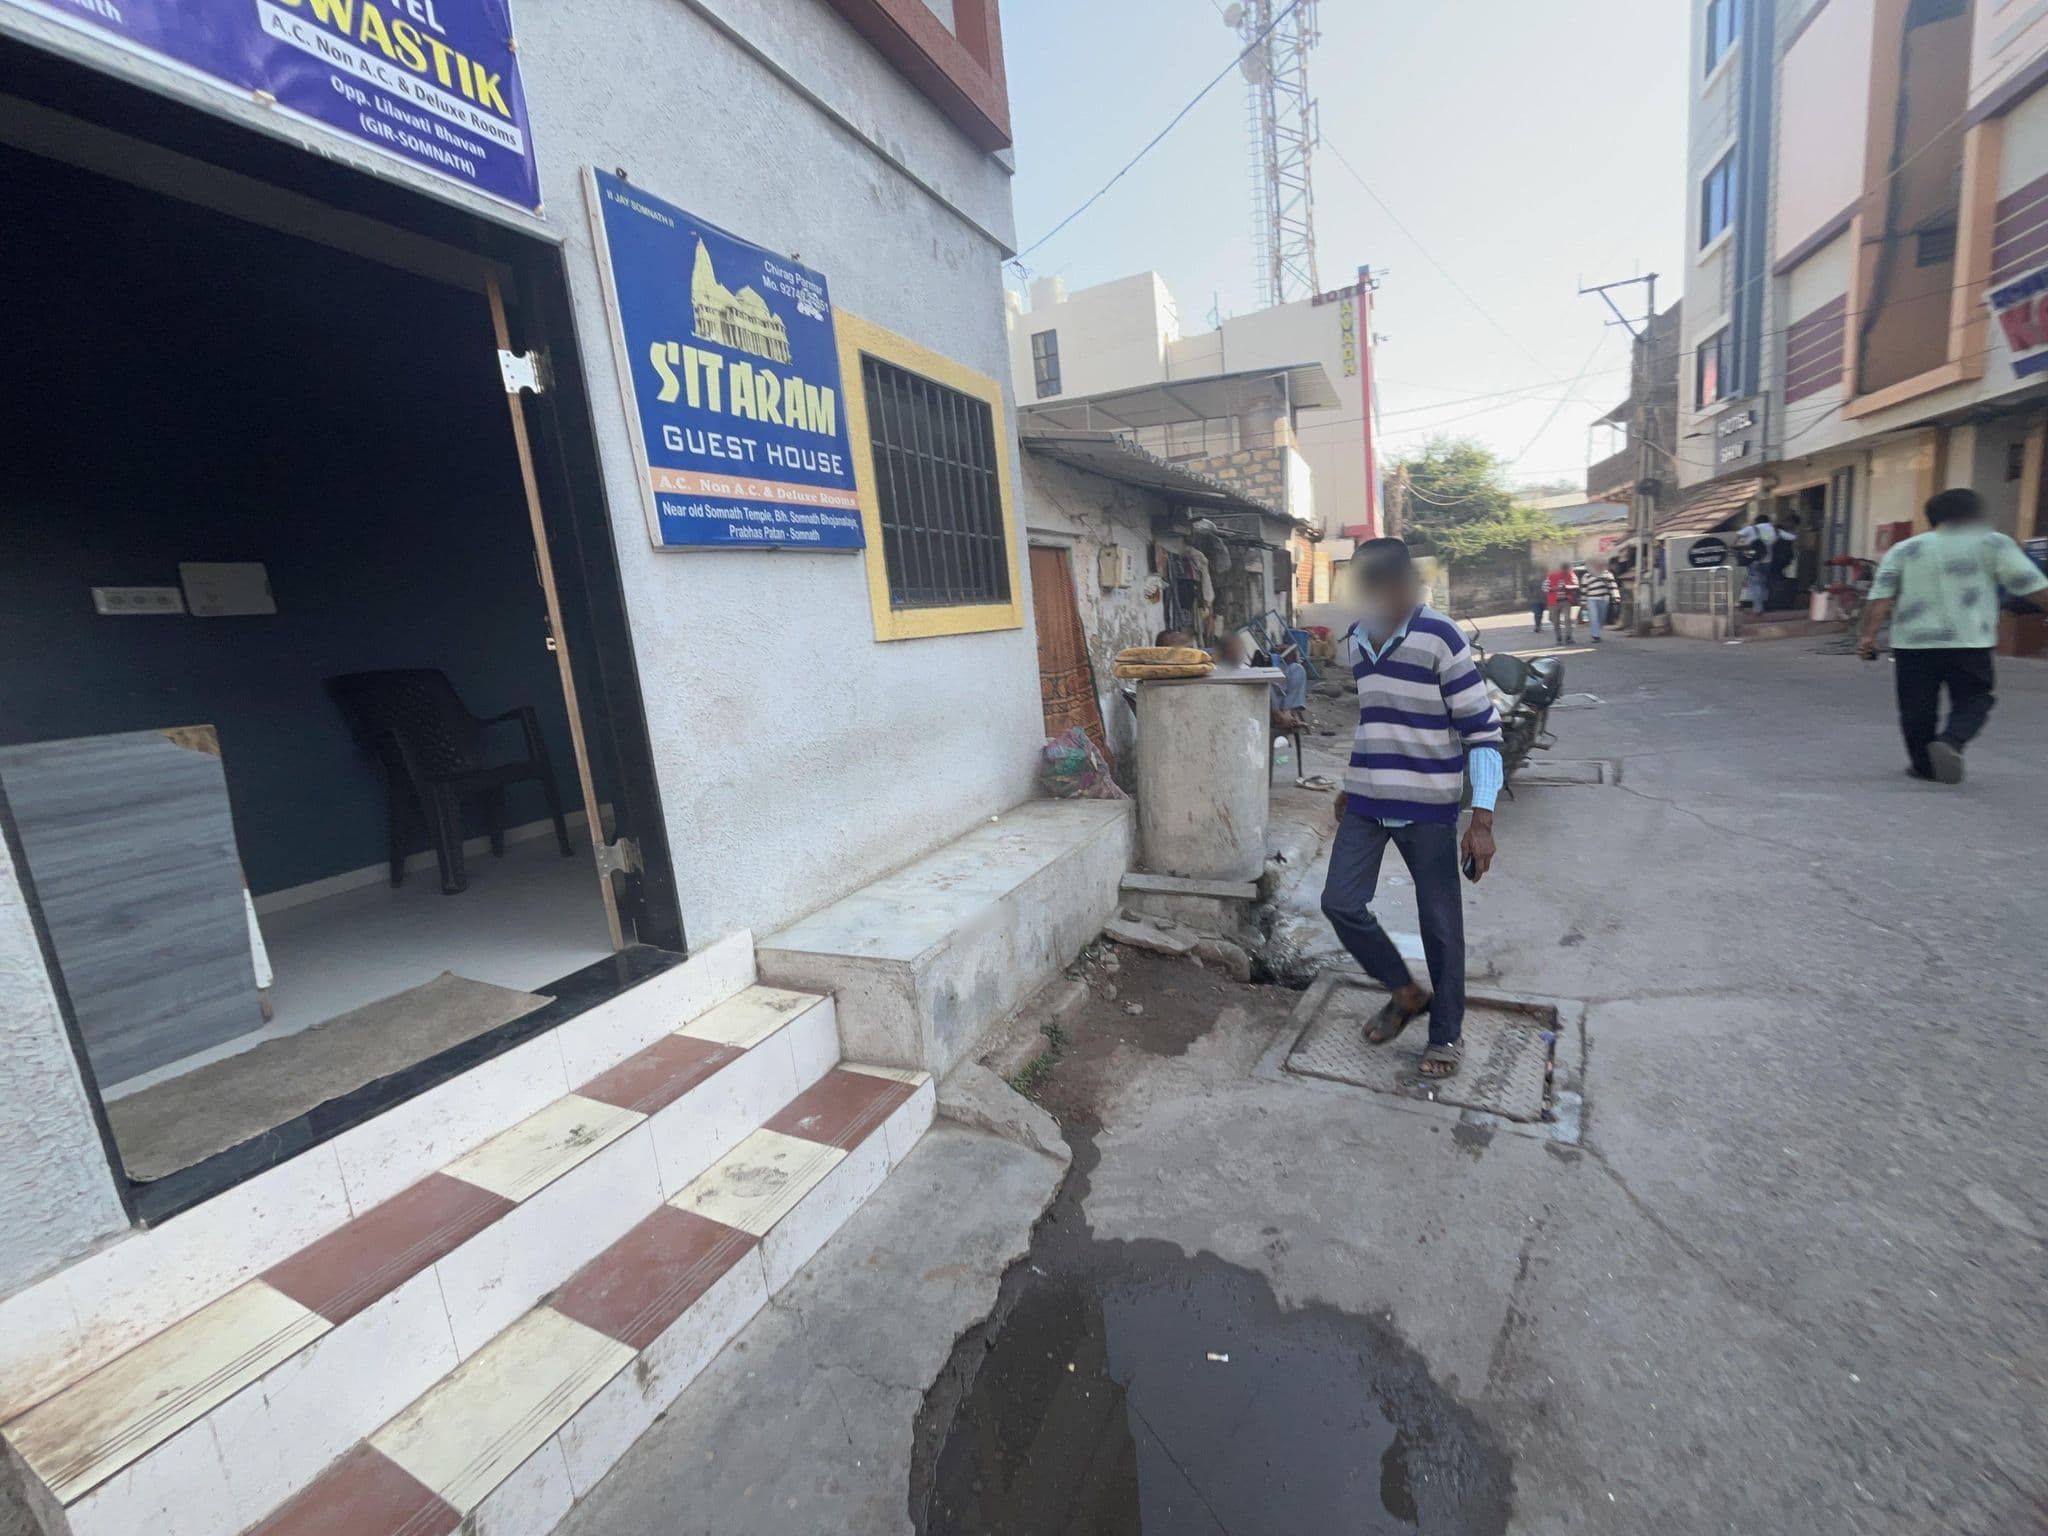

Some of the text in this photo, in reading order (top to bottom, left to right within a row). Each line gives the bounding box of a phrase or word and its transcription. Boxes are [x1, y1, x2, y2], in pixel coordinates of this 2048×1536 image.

[271, 13, 517, 146] A.C. Non A.C. & Deluxe Rooms
[279, 0, 512, 119] WASTIK
[330, 75, 487, 159] Opp. Lilavati Bhavan
[359, 112, 476, 178] (GIR-SOMNATH)
[762, 275, 780, 292] Mo.
[764, 260, 795, 285] Chirag
[650, 341, 836, 437] SITARAM
[662, 425, 844, 476] GUEST HOUSE
[659, 474, 856, 506] A.C. Non A.C. & Deluxe Rooms
[662, 501, 687, 517] Near
[688, 503, 704, 518] old
[704, 504, 743, 520] Somnath
[743, 507, 775, 524] Temple,
[789, 511, 820, 525] Somnath
[729, 524, 763, 539] Prabhas
[763, 526, 785, 539] Patan
[789, 527, 820, 541] Somnath
